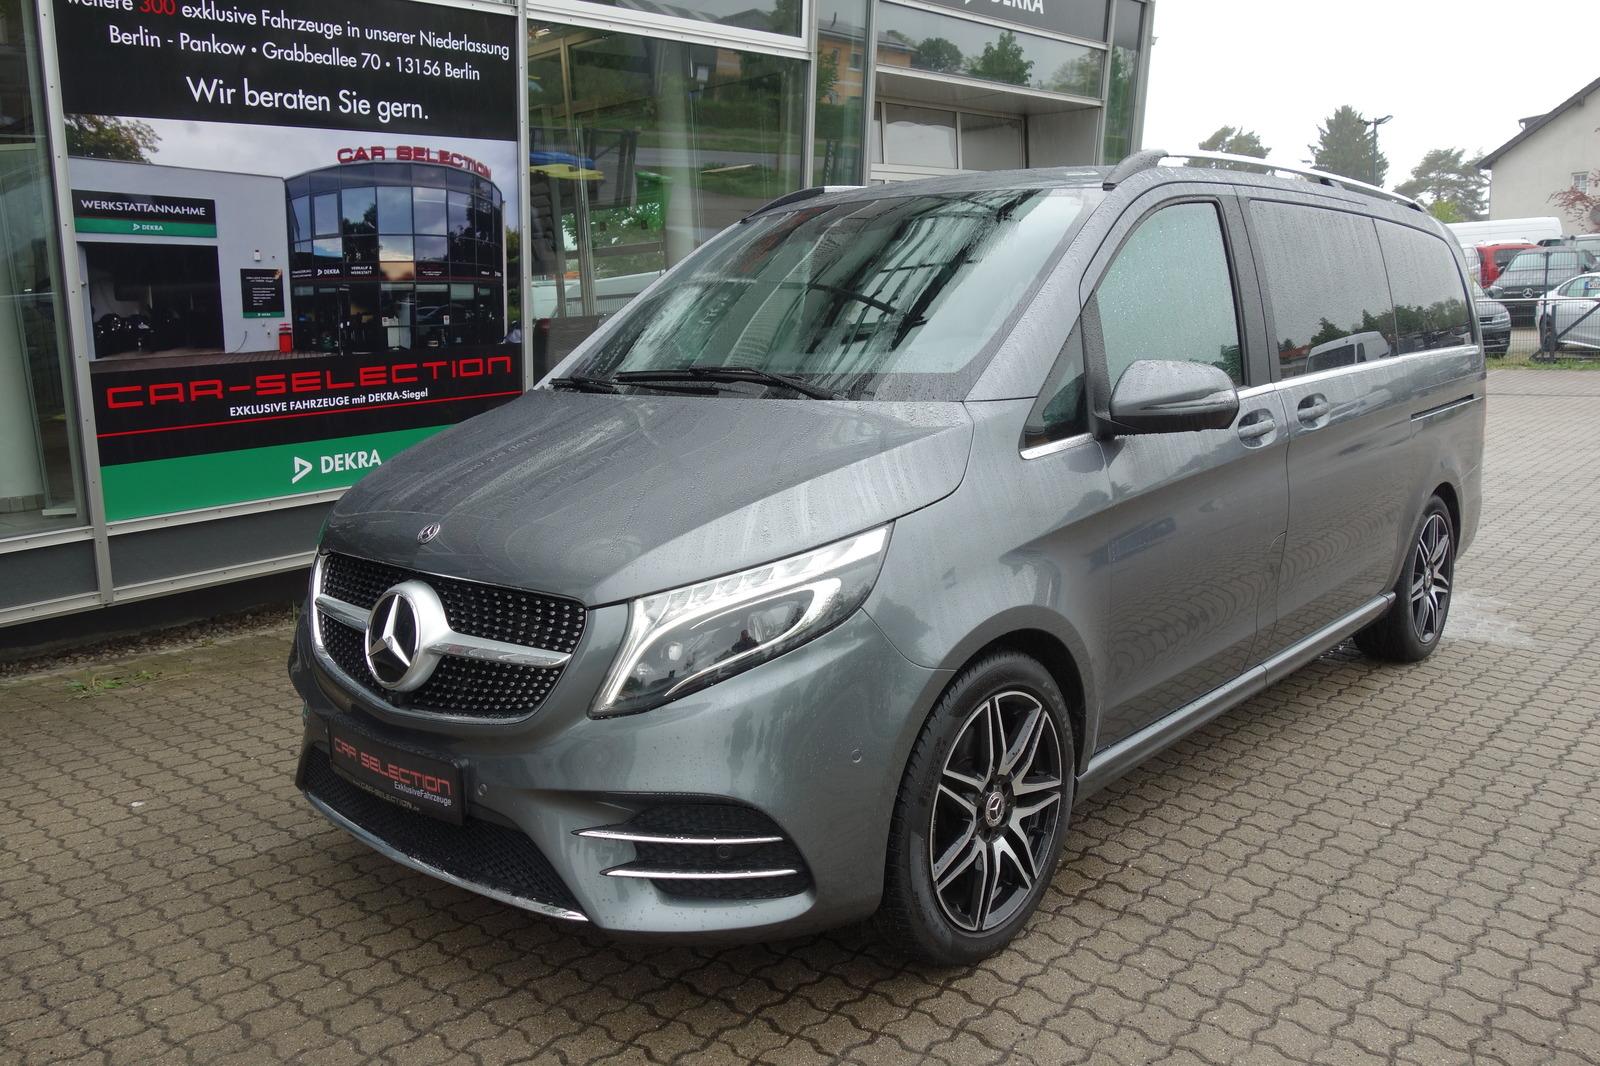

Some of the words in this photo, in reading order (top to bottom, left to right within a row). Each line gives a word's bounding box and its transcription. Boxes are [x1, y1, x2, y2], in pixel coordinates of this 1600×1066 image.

[139, 0, 176, 16] 300
[181, 1, 257, 26] exklusive
[262, 10, 342, 39] Fahrzeuge
[347, 21, 360, 38] in
[365, 30, 416, 45] unserer
[419, 30, 510, 61] Niederlassung
[109, 25, 161, 48] Berlin
[180, 32, 246, 56] Pankow
[262, 41, 357, 68] Grabbeallee
[361, 52, 381, 70] 70
[396, 56, 441, 76] 13156
[445, 62, 480, 81] Berlin
[186, 76, 236, 105] Wir
[244, 78, 331, 112] beraten
[338, 89, 371, 114] Sie
[377, 100, 429, 124] gern.
[337, 146, 386, 164] CAR
[396, 145, 492, 180] SELECTION
[81, 199, 206, 216] WERKSTATTANNAHME
[106, 356, 511, 409] CAR-SELECTION
[229, 401, 288, 417] EXKLUSIVE
[290, 395, 350, 411] FAHRZEUGE
[352, 394, 367, 405] mit
[368, 388, 429, 403] DEKRA-Siegel
[320, 449, 382, 474] DEKRA
[335, 737, 357, 761] CAR
[360, 751, 451, 795] SELECTION
[394, 780, 452, 806] ExklusiveFahrzeuge
